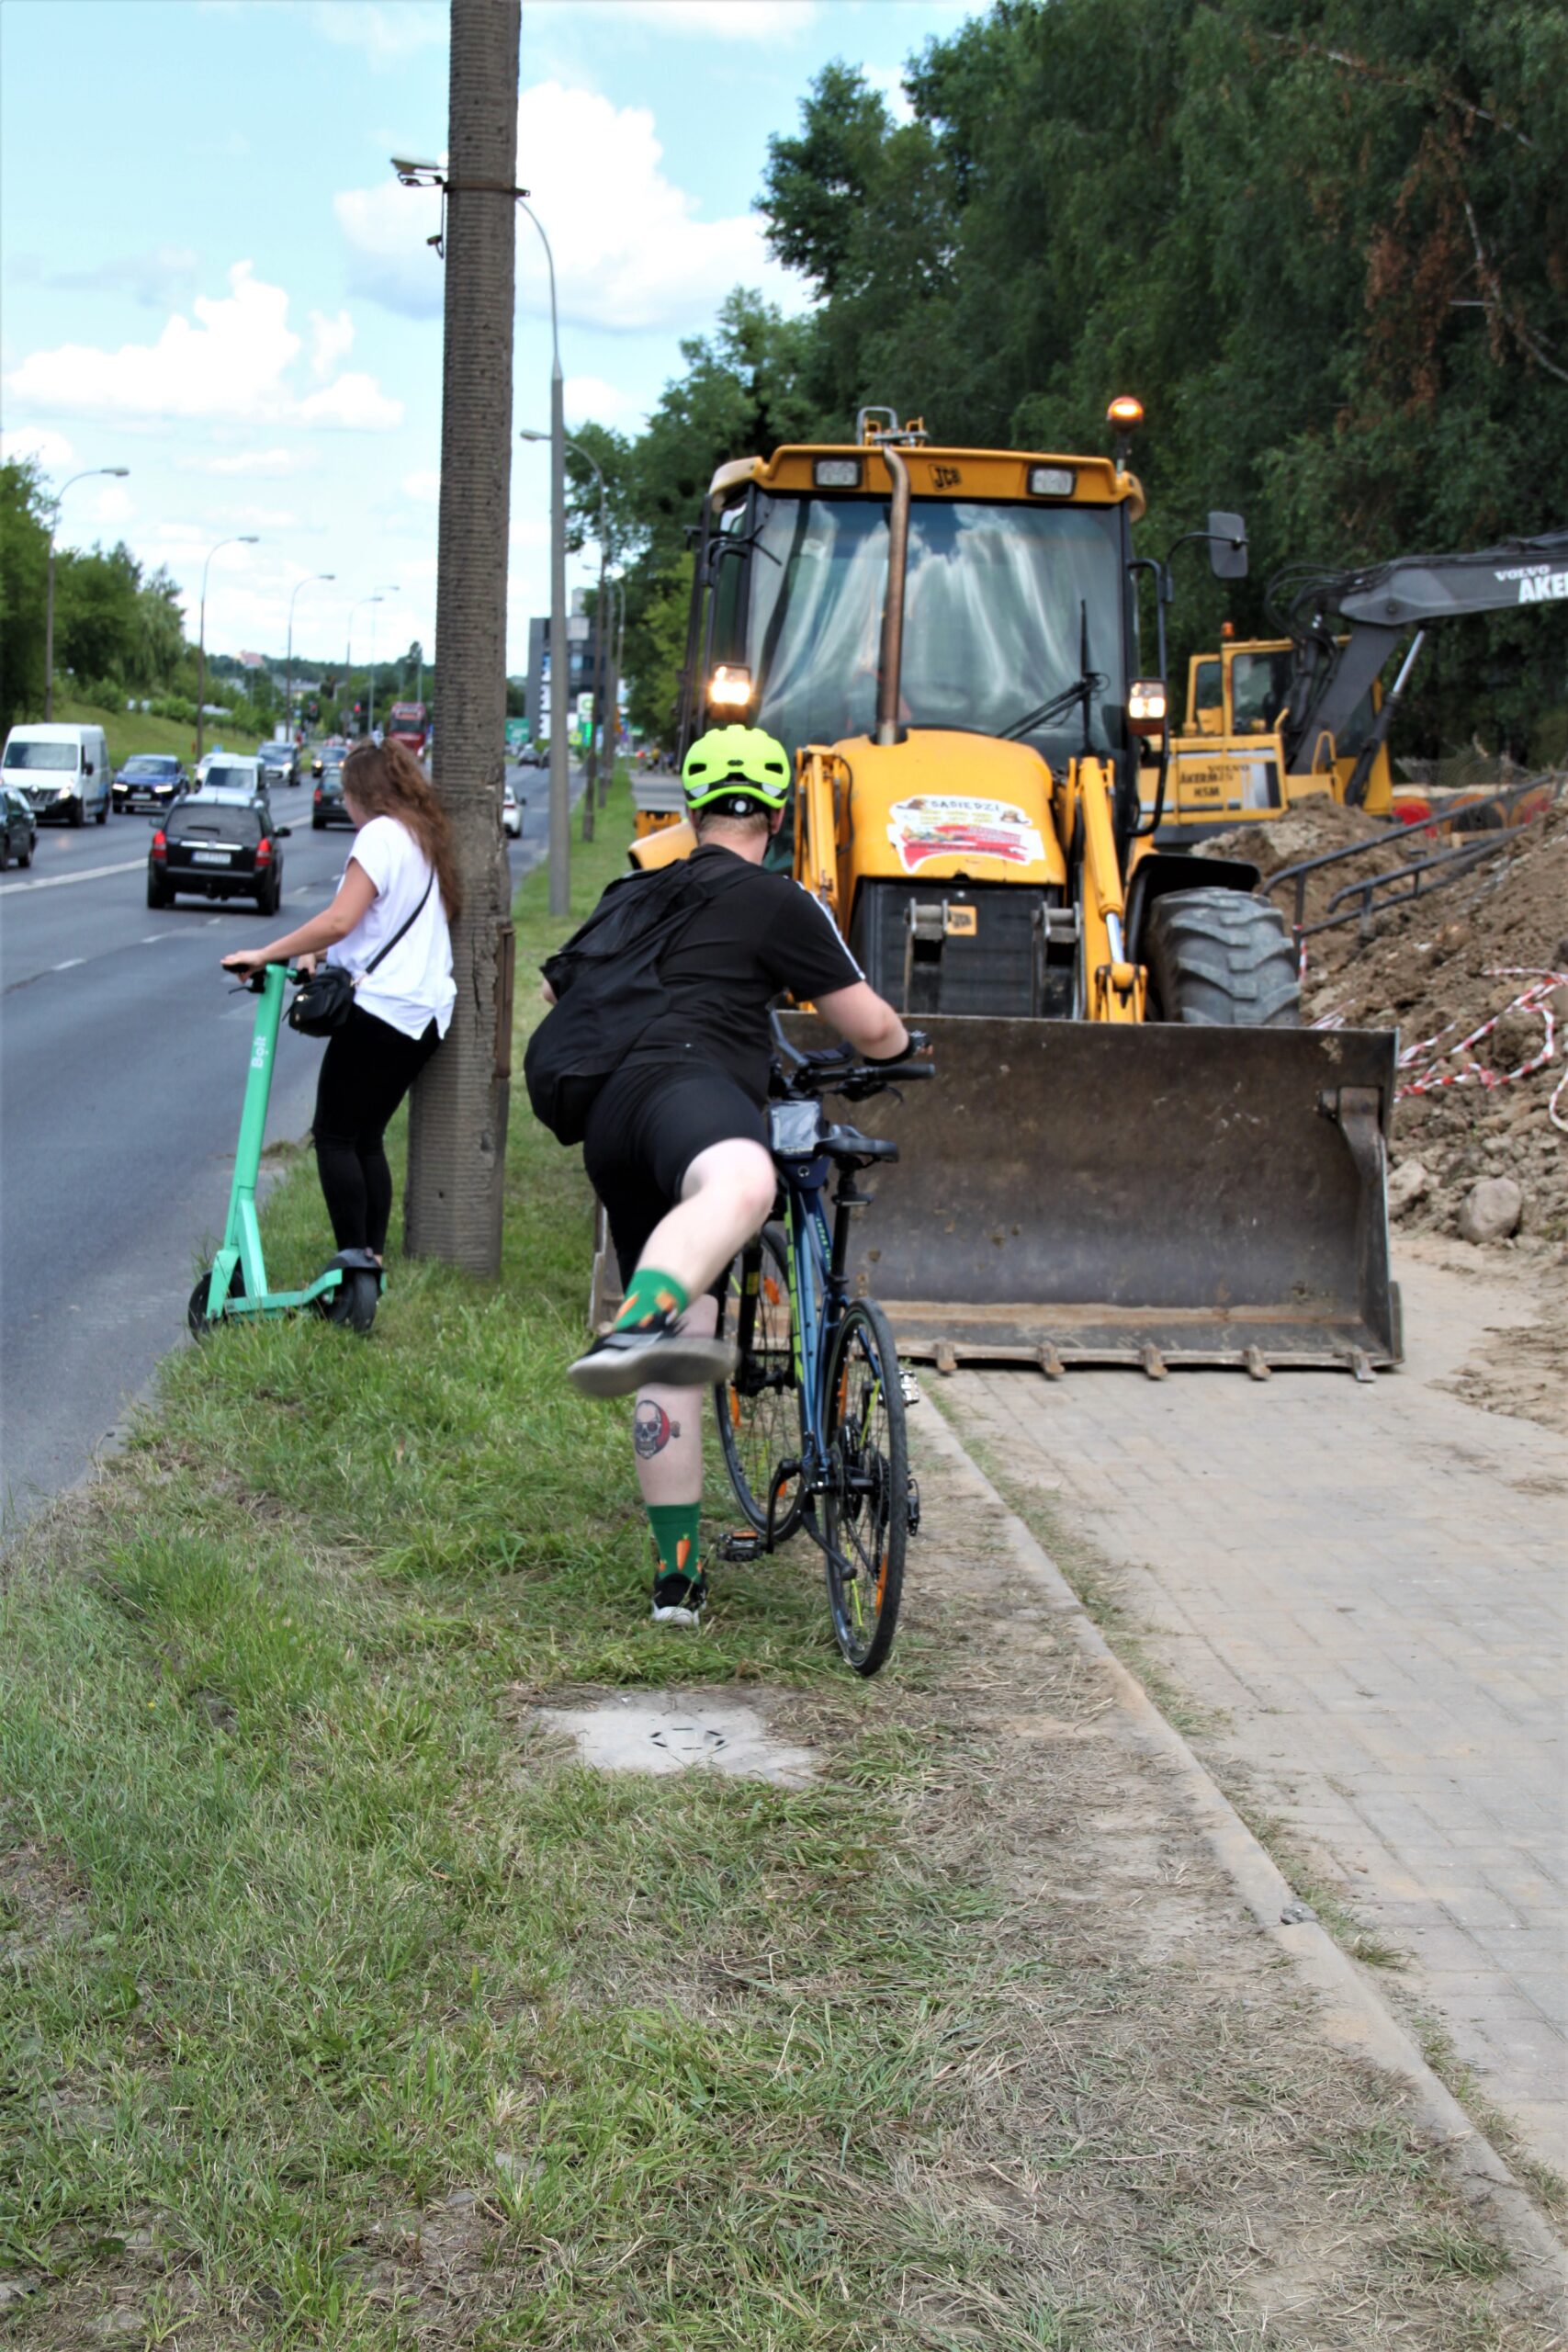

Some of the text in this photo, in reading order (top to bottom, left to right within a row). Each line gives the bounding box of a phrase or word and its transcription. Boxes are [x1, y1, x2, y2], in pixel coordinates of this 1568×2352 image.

[929, 464, 962, 490] JCB
[1494, 564, 1551, 582] VOLVO
[1518, 571, 1568, 603] AKE
[1208, 763, 1249, 774] VOLVO
[251, 1035, 268, 1069] Bolt
